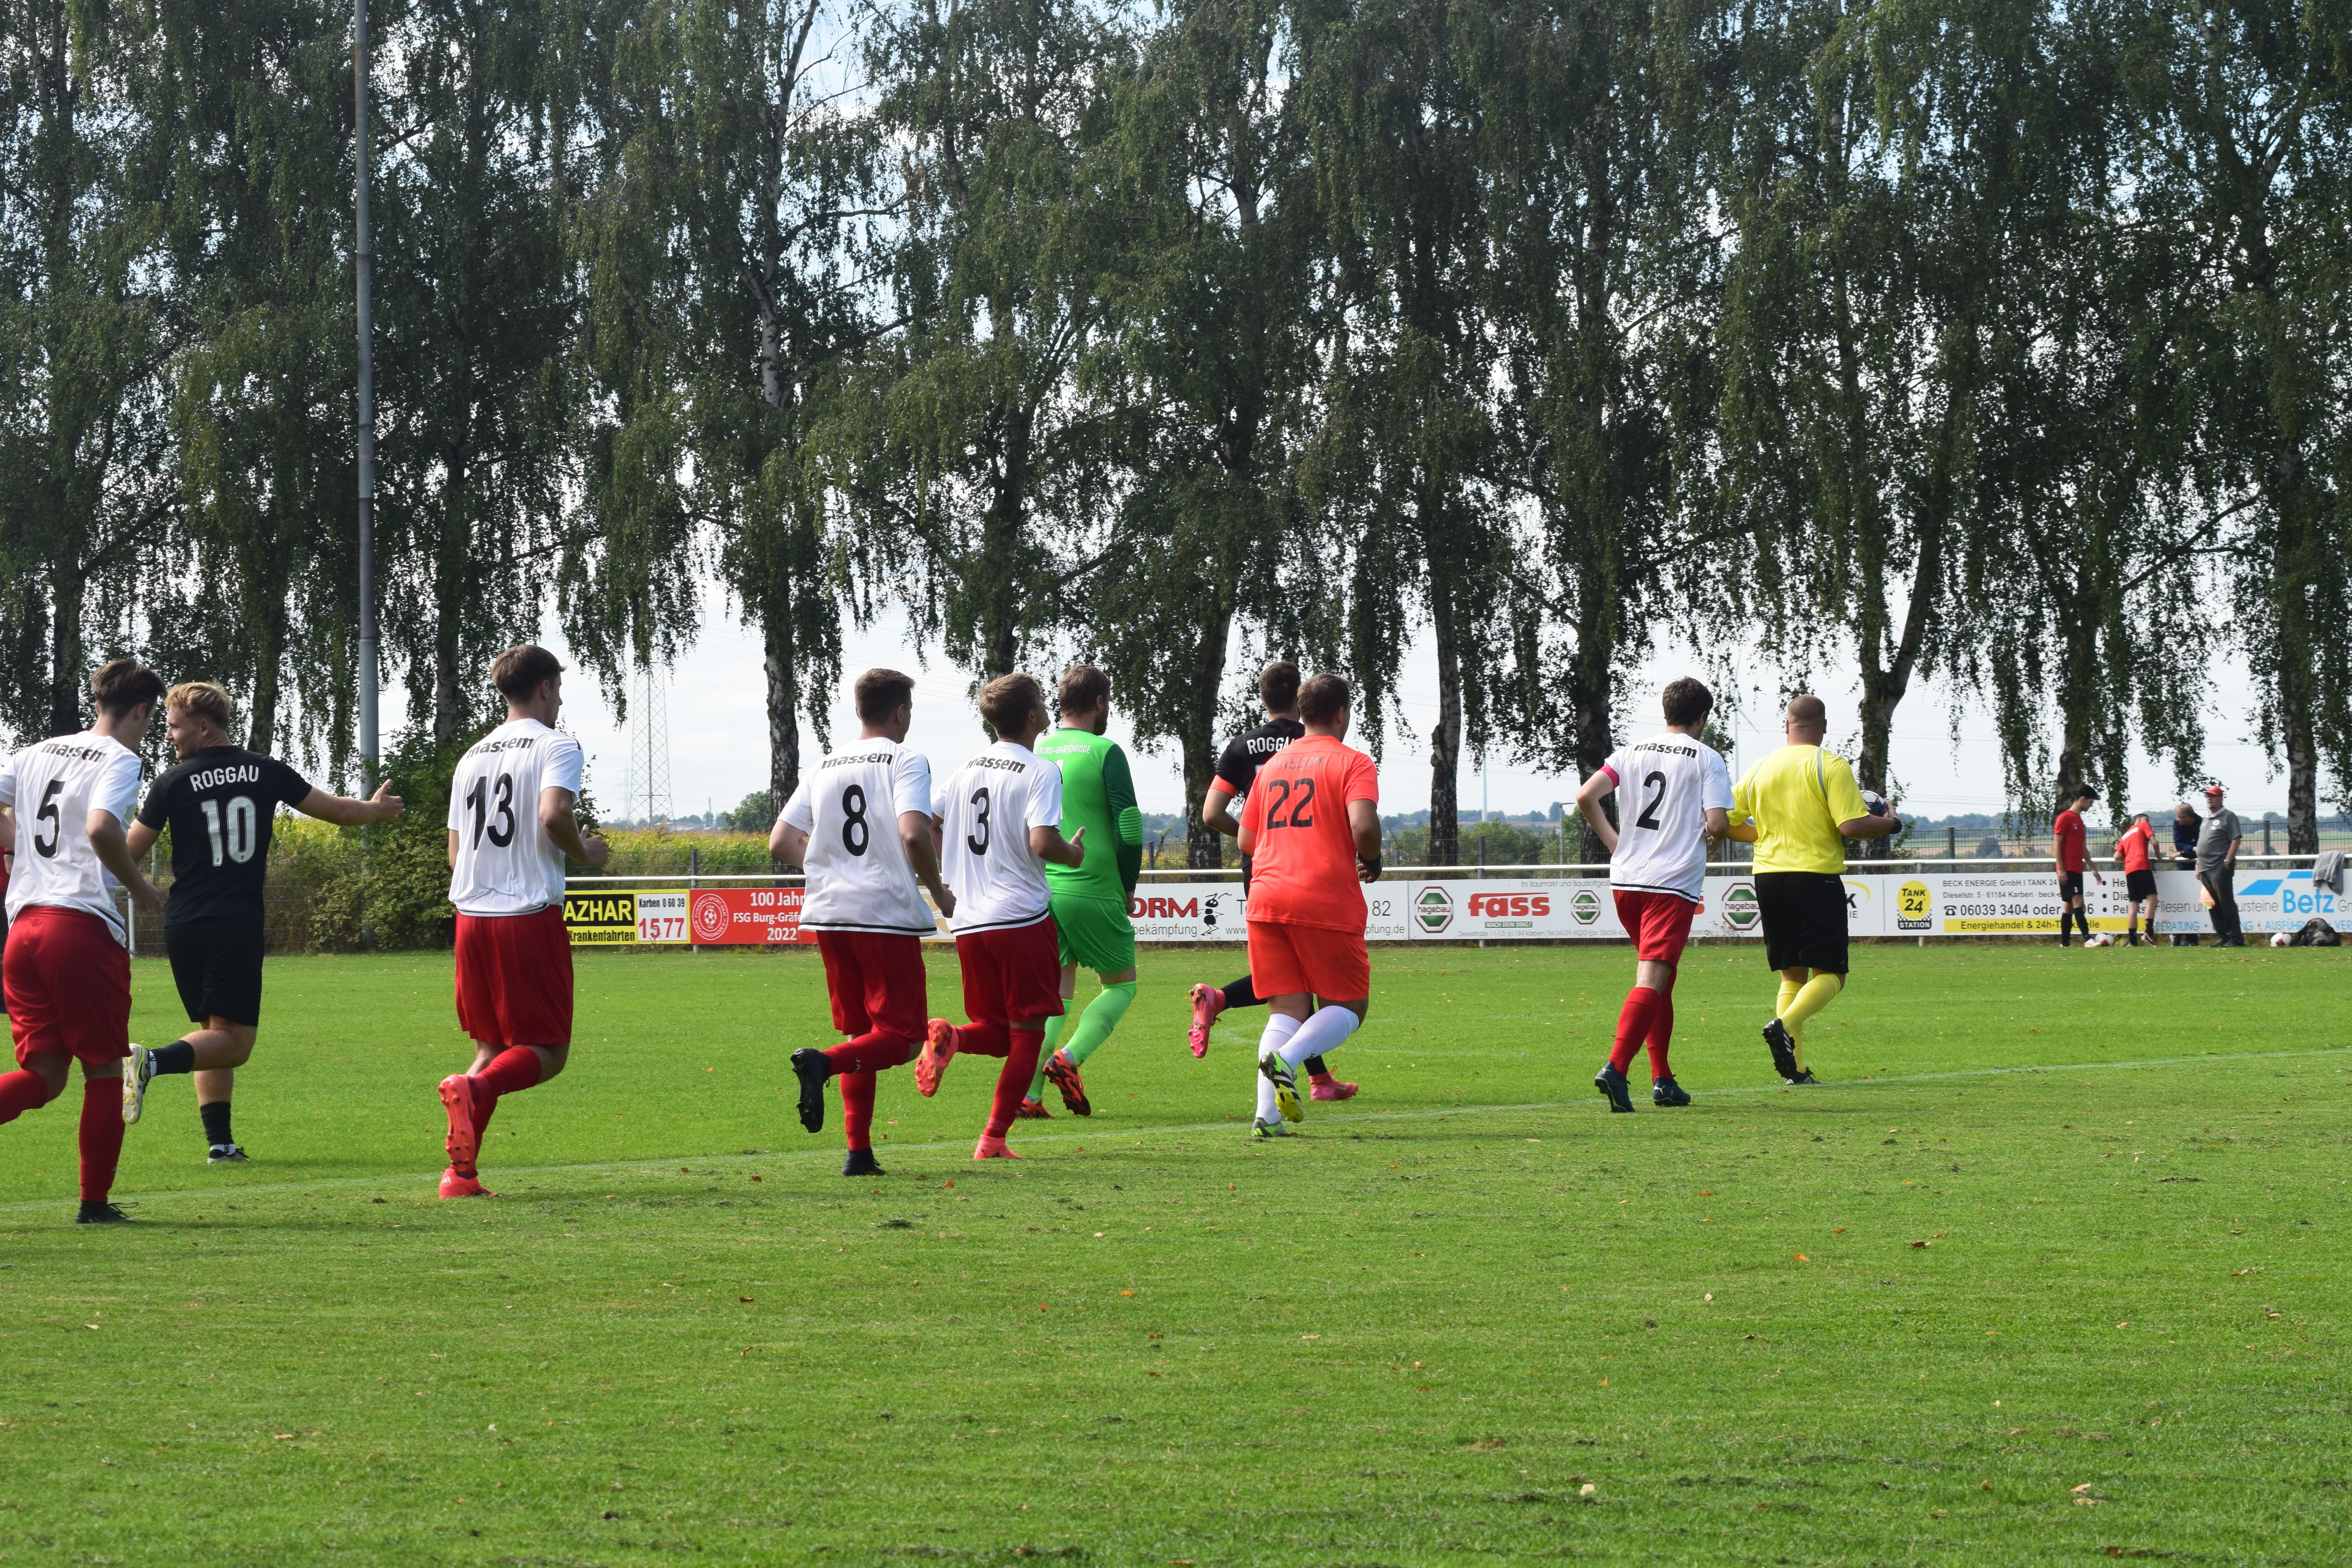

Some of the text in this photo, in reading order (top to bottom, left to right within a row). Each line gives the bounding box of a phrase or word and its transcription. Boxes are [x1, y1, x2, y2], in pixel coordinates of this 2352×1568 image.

[1247, 736, 1295, 754] ROGGA
[1634, 743, 1697, 759] massem
[821, 753, 893, 769] massem
[966, 757, 1026, 774] massem
[189, 765, 259, 792] ROGGAU
[1267, 778, 1315, 830] 22
[1635, 771, 1667, 831] 2
[34, 779, 66, 858] 5
[466, 772, 515, 851] 13
[842, 784, 869, 857] 8
[967, 787, 990, 856] 3
[200, 796, 256, 867] 10
[1573, 880, 1611, 888] Baustoffgroß
[750, 891, 805, 906] 100 Jahr
[1902, 888, 1926, 897] TANK
[639, 898, 685, 908] Karben 0 60 39
[1128, 897, 1198, 918] ORM
[1372, 900, 1391, 916] 82
[1468, 892, 1550, 918] fass
[1904, 898, 1923, 913] 24
[2238, 900, 2279, 912] ursteine
[2283, 889, 2334, 913] Betz
[563, 900, 633, 921] AZHAR
[1417, 905, 1450, 914] hagebau
[1960, 904, 2061, 916] 06039 3404 oder
[733, 911, 801, 925] FSG Burg-Gräfe
[1961, 921, 2024, 931] Energiehandel
[767, 927, 797, 940] 2022
[1133, 924, 1197, 937] bekämpfung
[2156, 922, 2200, 932] BERATUNG
[568, 930, 635, 942] Krankenfahrten
